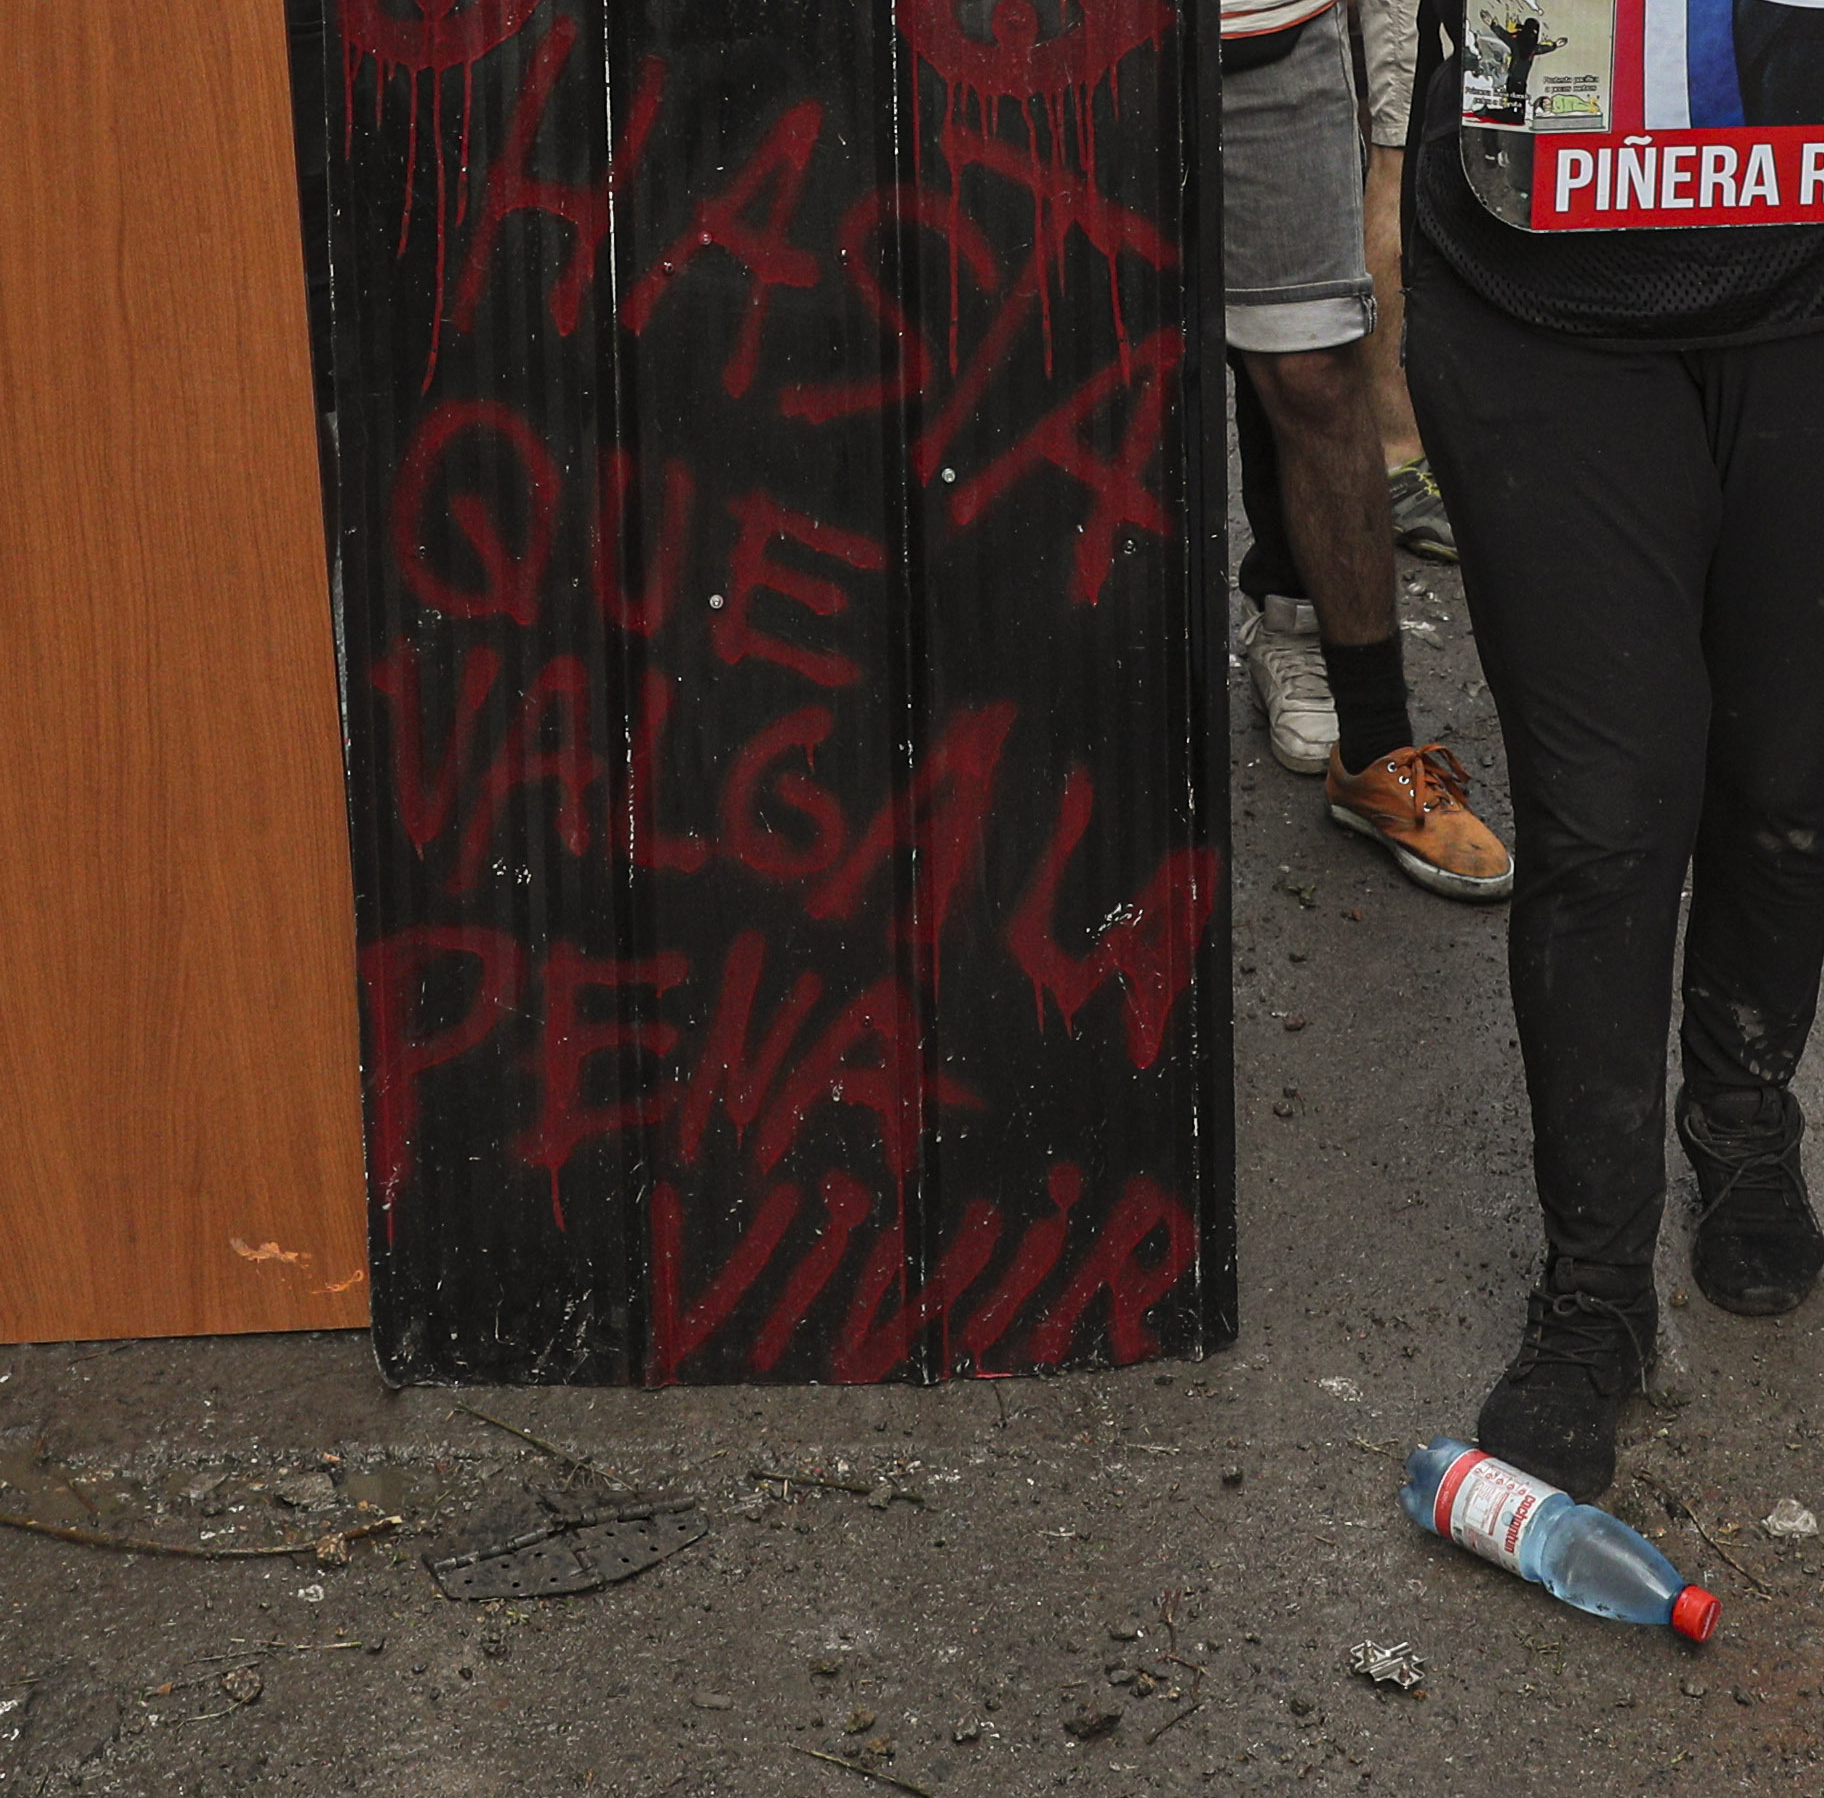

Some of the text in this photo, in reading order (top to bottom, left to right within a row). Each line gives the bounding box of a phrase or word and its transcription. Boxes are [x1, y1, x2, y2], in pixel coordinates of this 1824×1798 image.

[448, 14, 1186, 607] HASTA
[1555, 134, 1780, 213] PIÑERA
[392, 402, 887, 688] QUE
[372, 636, 1219, 1070] VALGA LA
[360, 924, 986, 1232] PENA
